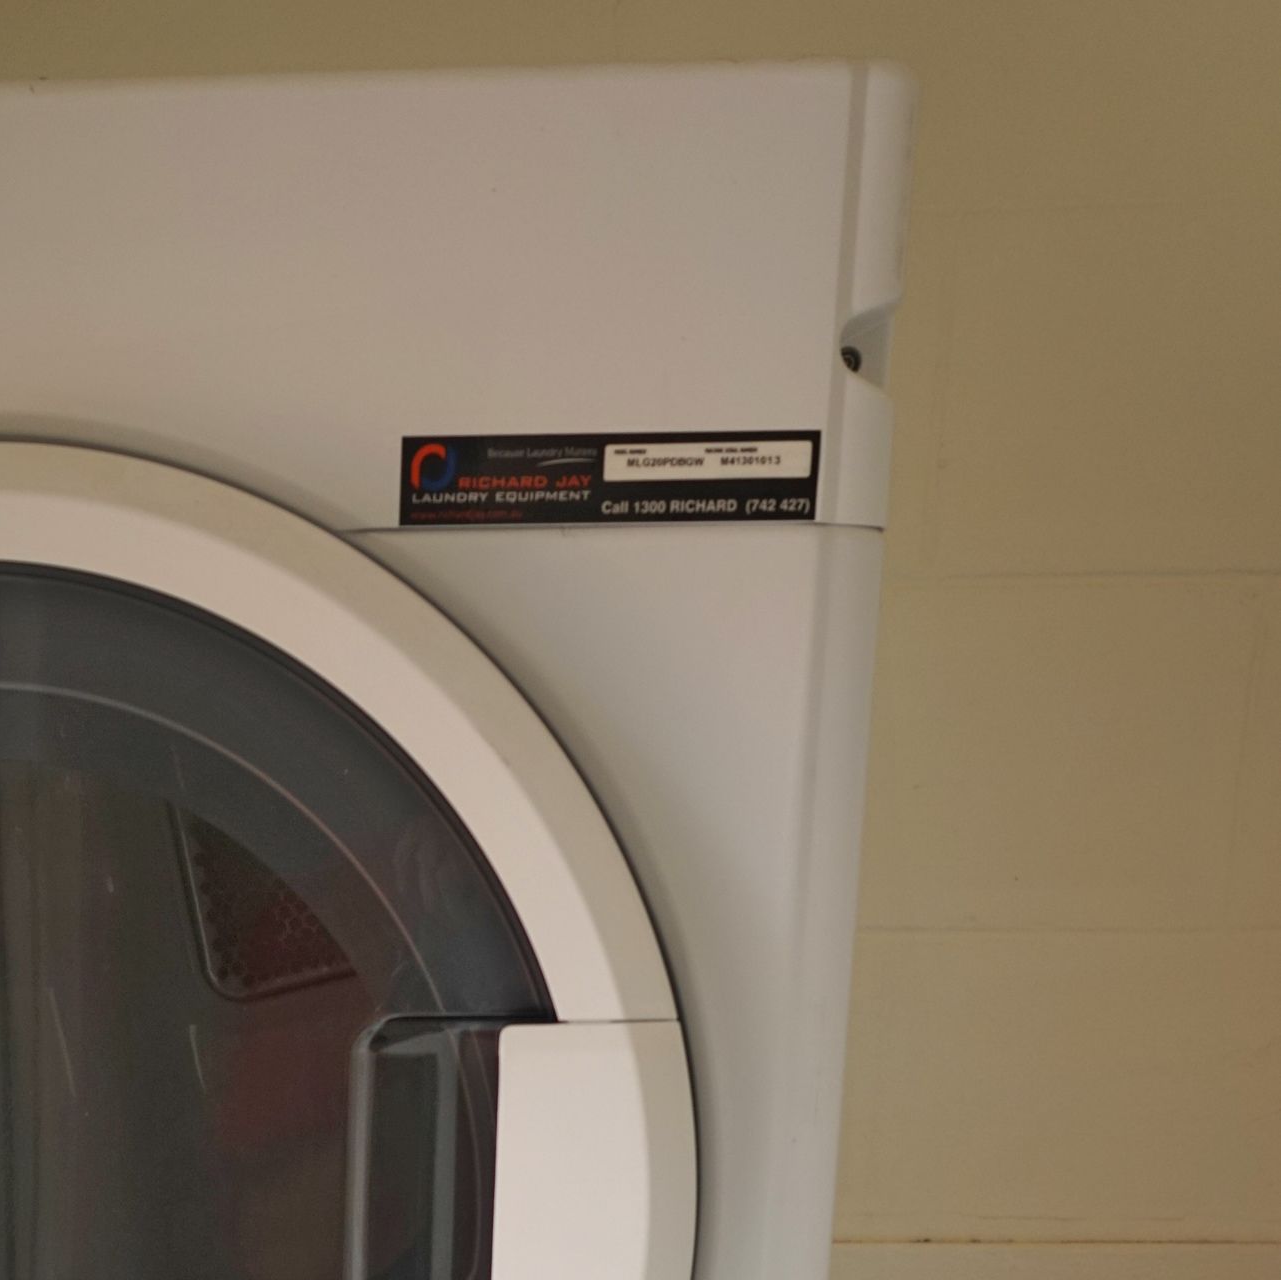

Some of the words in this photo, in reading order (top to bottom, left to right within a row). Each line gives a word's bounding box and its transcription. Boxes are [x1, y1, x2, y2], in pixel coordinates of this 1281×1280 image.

[458, 476, 548, 489] RICHARD
[556, 475, 592, 489] JAY
[412, 491, 488, 504] LAUNDRY
[495, 490, 591, 503] EQUIPMENT
[601, 501, 629, 514] Call
[634, 501, 666, 513] 1300
[670, 499, 738, 512] RICHARD
[745, 499, 776, 515] (742
[780, 498, 810, 514] 427)
